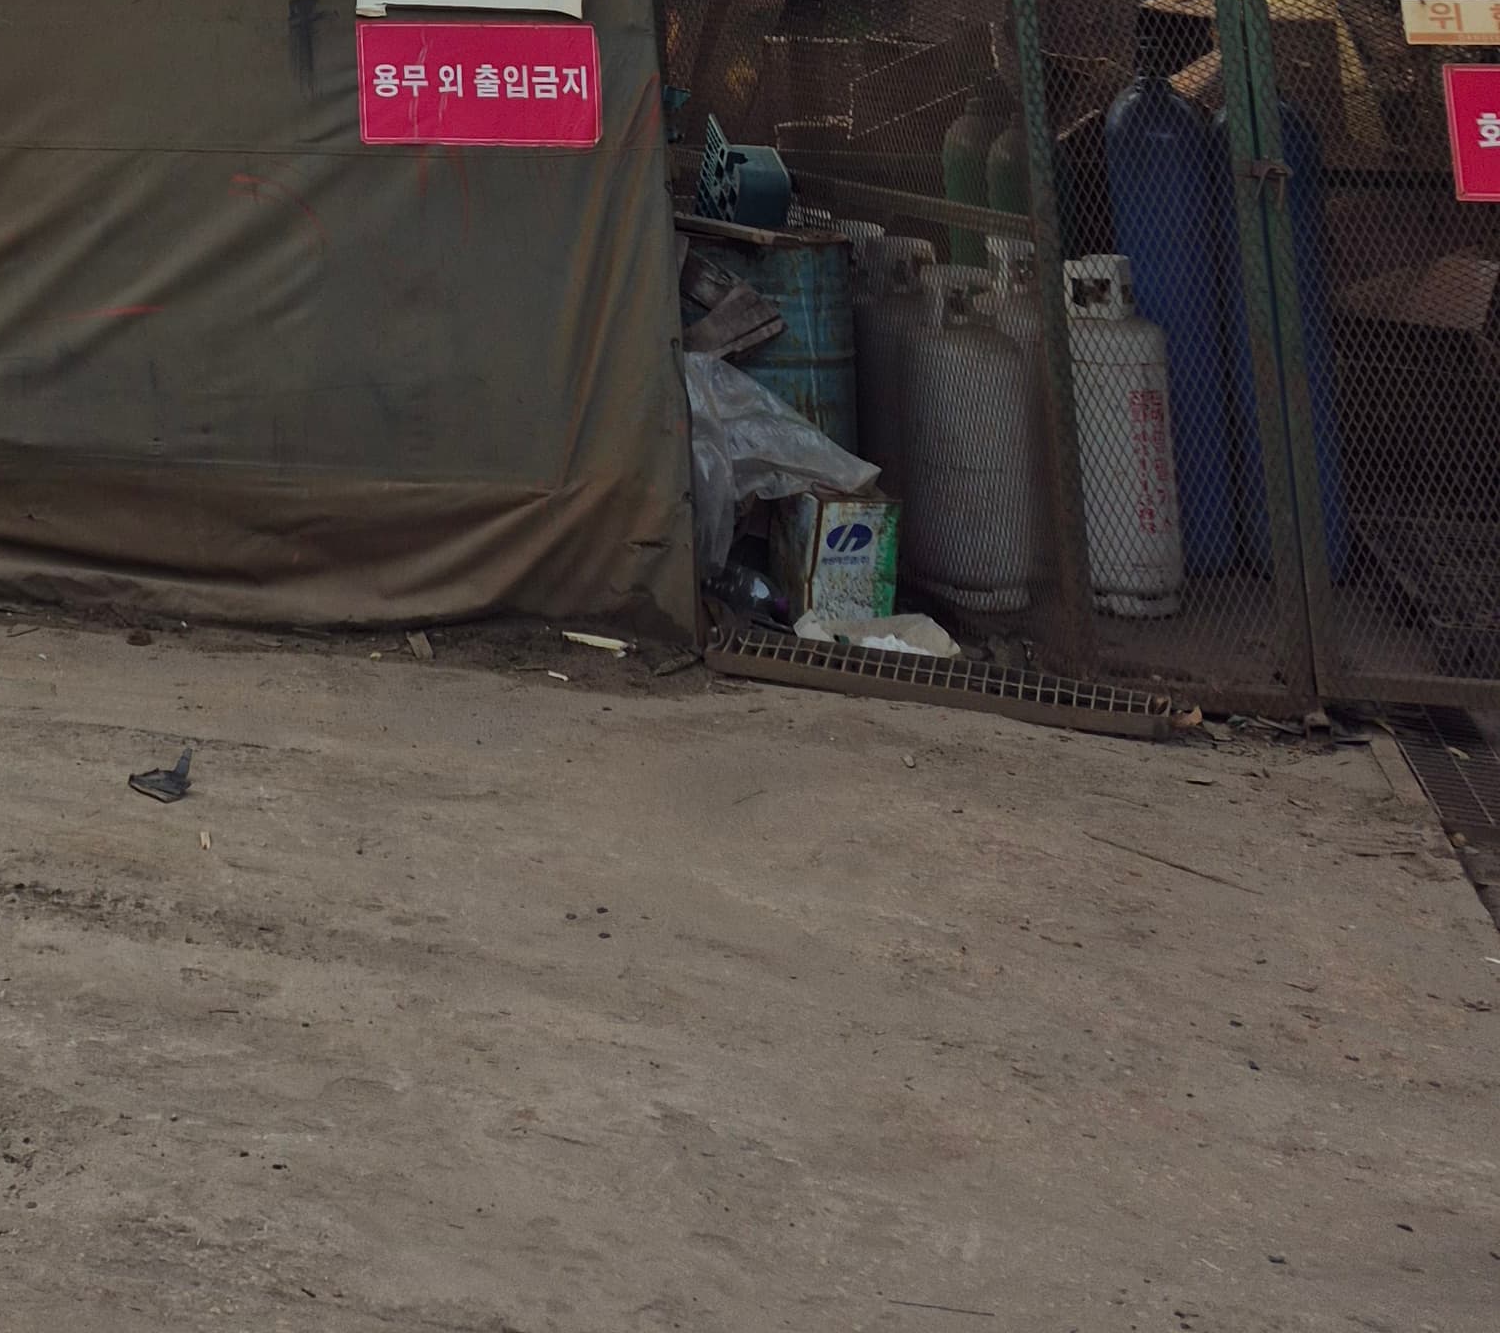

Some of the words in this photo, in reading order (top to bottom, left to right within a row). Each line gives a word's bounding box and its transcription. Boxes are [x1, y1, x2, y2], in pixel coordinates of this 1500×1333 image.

[372, 63, 429, 98] 용무
[438, 64, 464, 97] 외
[473, 63, 588, 100] 출입금지
